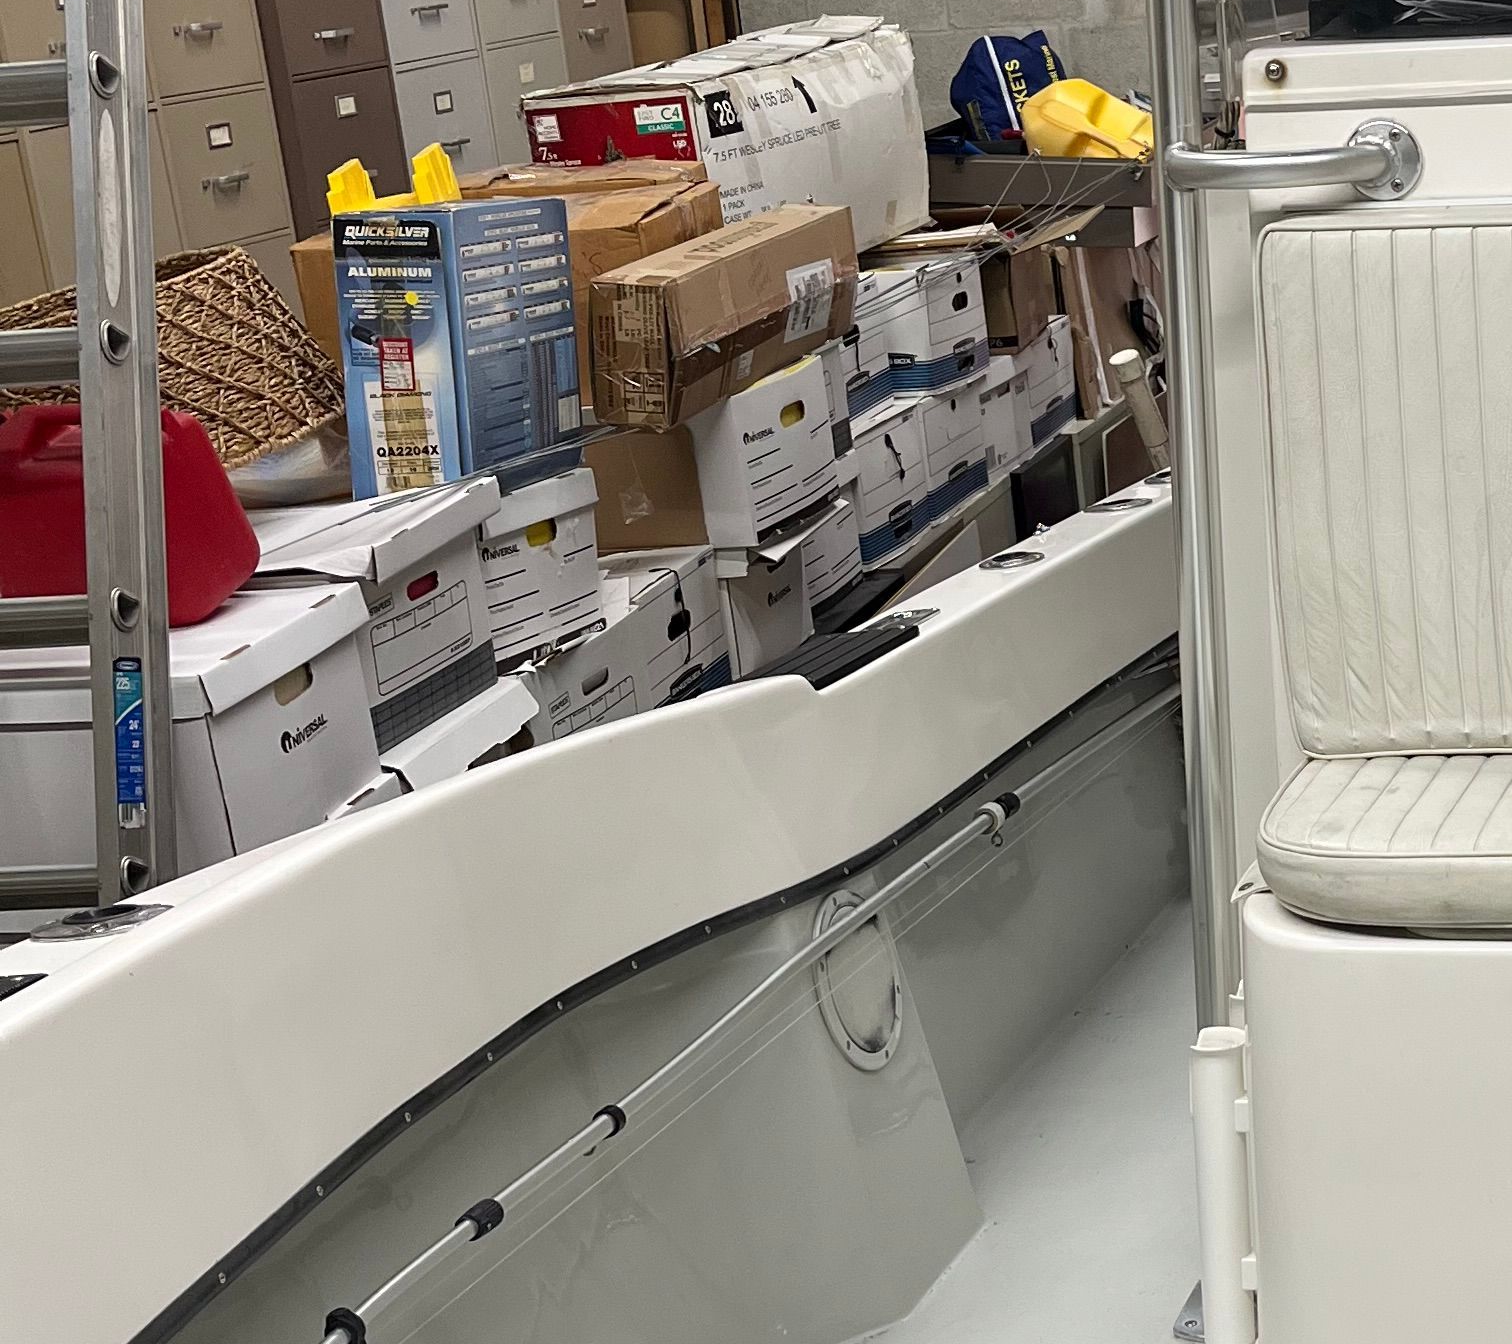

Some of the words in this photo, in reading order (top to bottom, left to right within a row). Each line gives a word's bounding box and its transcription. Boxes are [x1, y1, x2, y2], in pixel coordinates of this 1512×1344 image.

[761, 93, 778, 107] 155
[660, 107, 681, 121] C4
[713, 100, 736, 127] 28
[647, 122, 675, 132] CLASSIC
[728, 147, 738, 159] FT
[768, 133, 794, 151] SPRUCE
[793, 129, 804, 142] LED
[826, 118, 842, 132] TREE
[720, 186, 739, 199] MADE
[740, 185, 747, 194] IN
[747, 180, 765, 192] CHINA
[727, 199, 745, 210] PACK
[724, 213, 742, 225] CASE
[344, 225, 430, 240] QUICKSILVER
[347, 266, 433, 278] ALUMINUM
[376, 444, 440, 458] QA2204X
[481, 543, 521, 562] UNIVERSAL
[280, 713, 329, 754] UNIVERSAL
